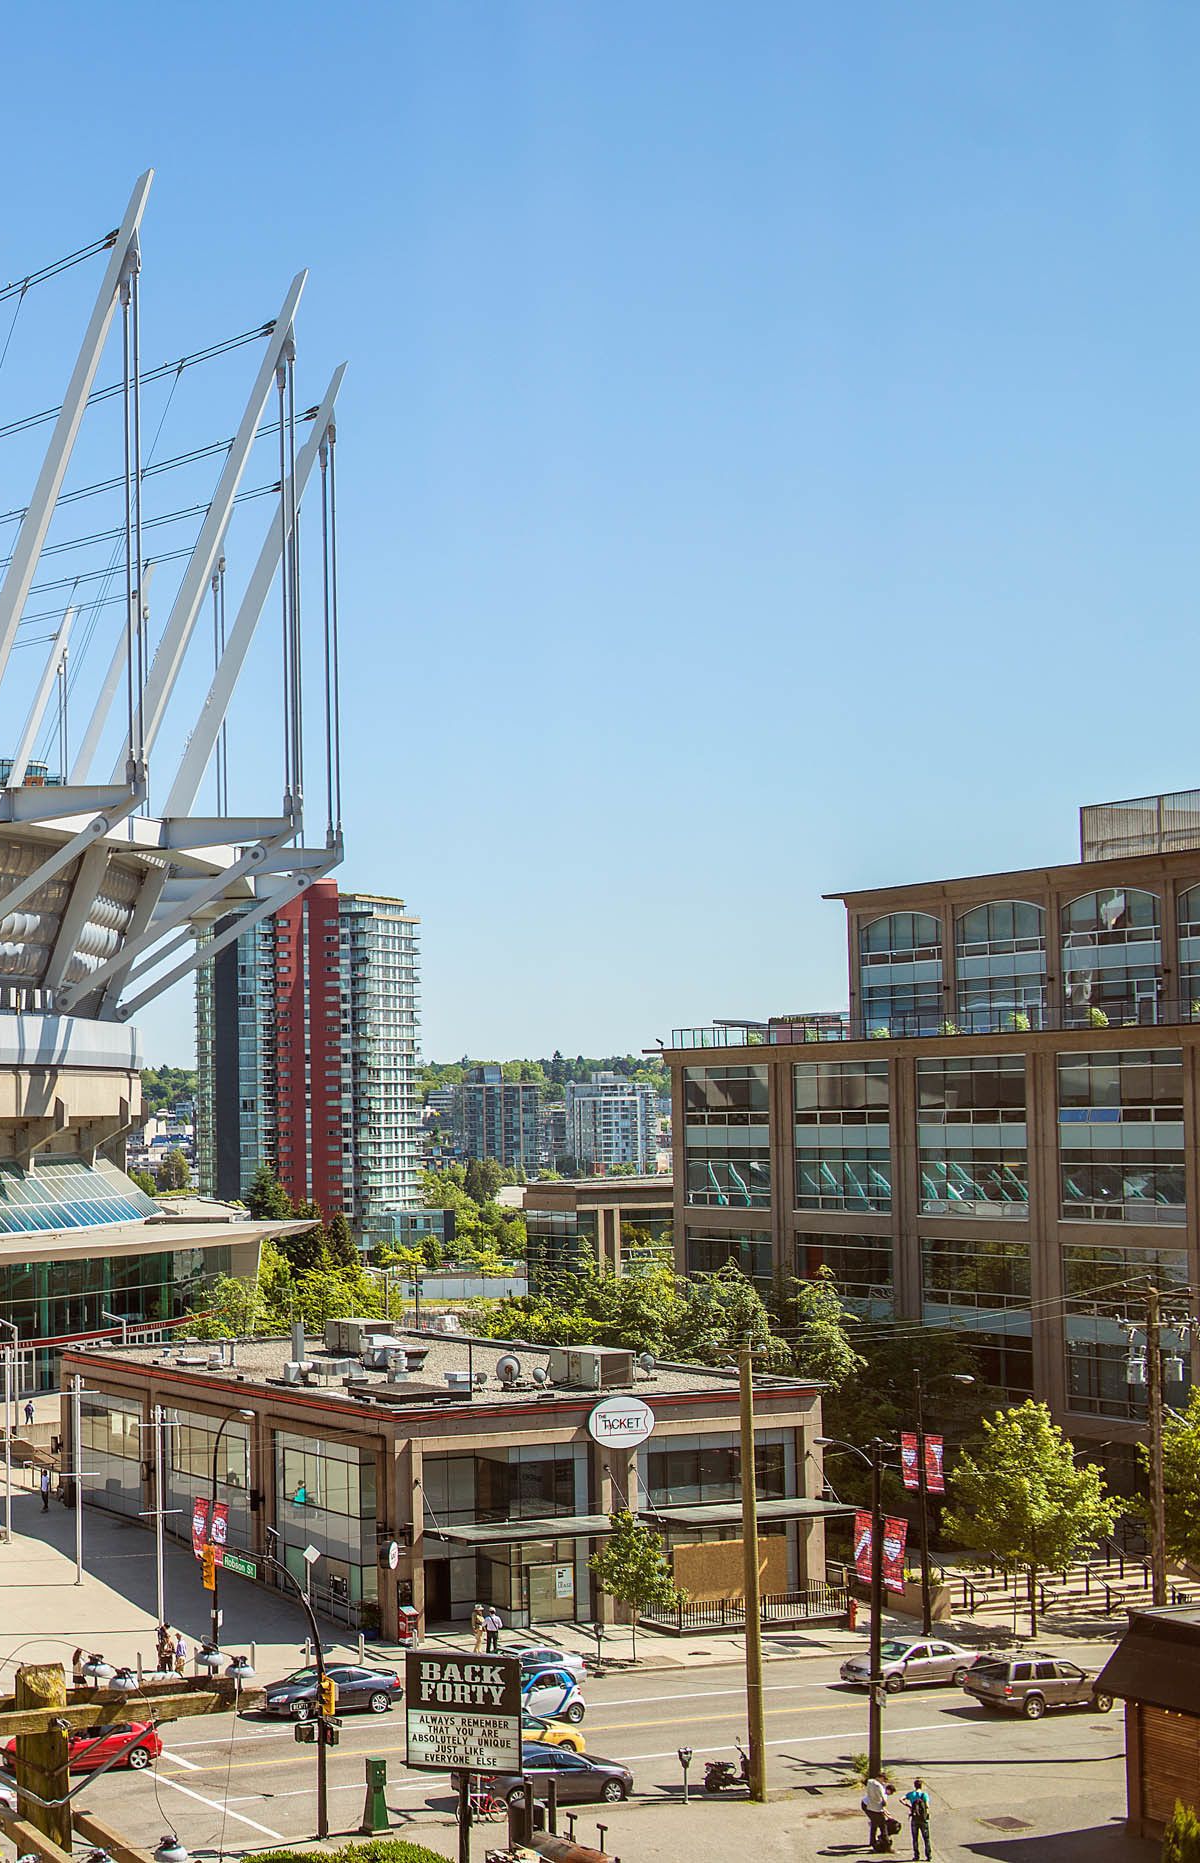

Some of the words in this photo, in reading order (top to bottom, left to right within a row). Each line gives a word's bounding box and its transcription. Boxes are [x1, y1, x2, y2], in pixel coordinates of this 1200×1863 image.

[602, 1417, 641, 1430] TICKET
[224, 1555, 246, 1573] Robson
[246, 1564, 254, 1576] St
[420, 1661, 506, 1685] BACK
[420, 1681, 506, 1706] FORTY
[419, 1715, 455, 1725] ALWAYS
[461, 1718, 509, 1729] REMEMBER
[428, 1725, 449, 1735] THAT
[456, 1727, 474, 1736] YOU
[481, 1729, 499, 1738] ARE
[412, 1734, 468, 1745] ABSOLUTELY
[478, 1738, 511, 1748] UNIQUE
[435, 1745, 457, 1754] JUST
[464, 1746, 485, 1756] LIKE
[424, 1753, 470, 1765] EVERYONE
[476, 1757, 497, 1766] ELSE
